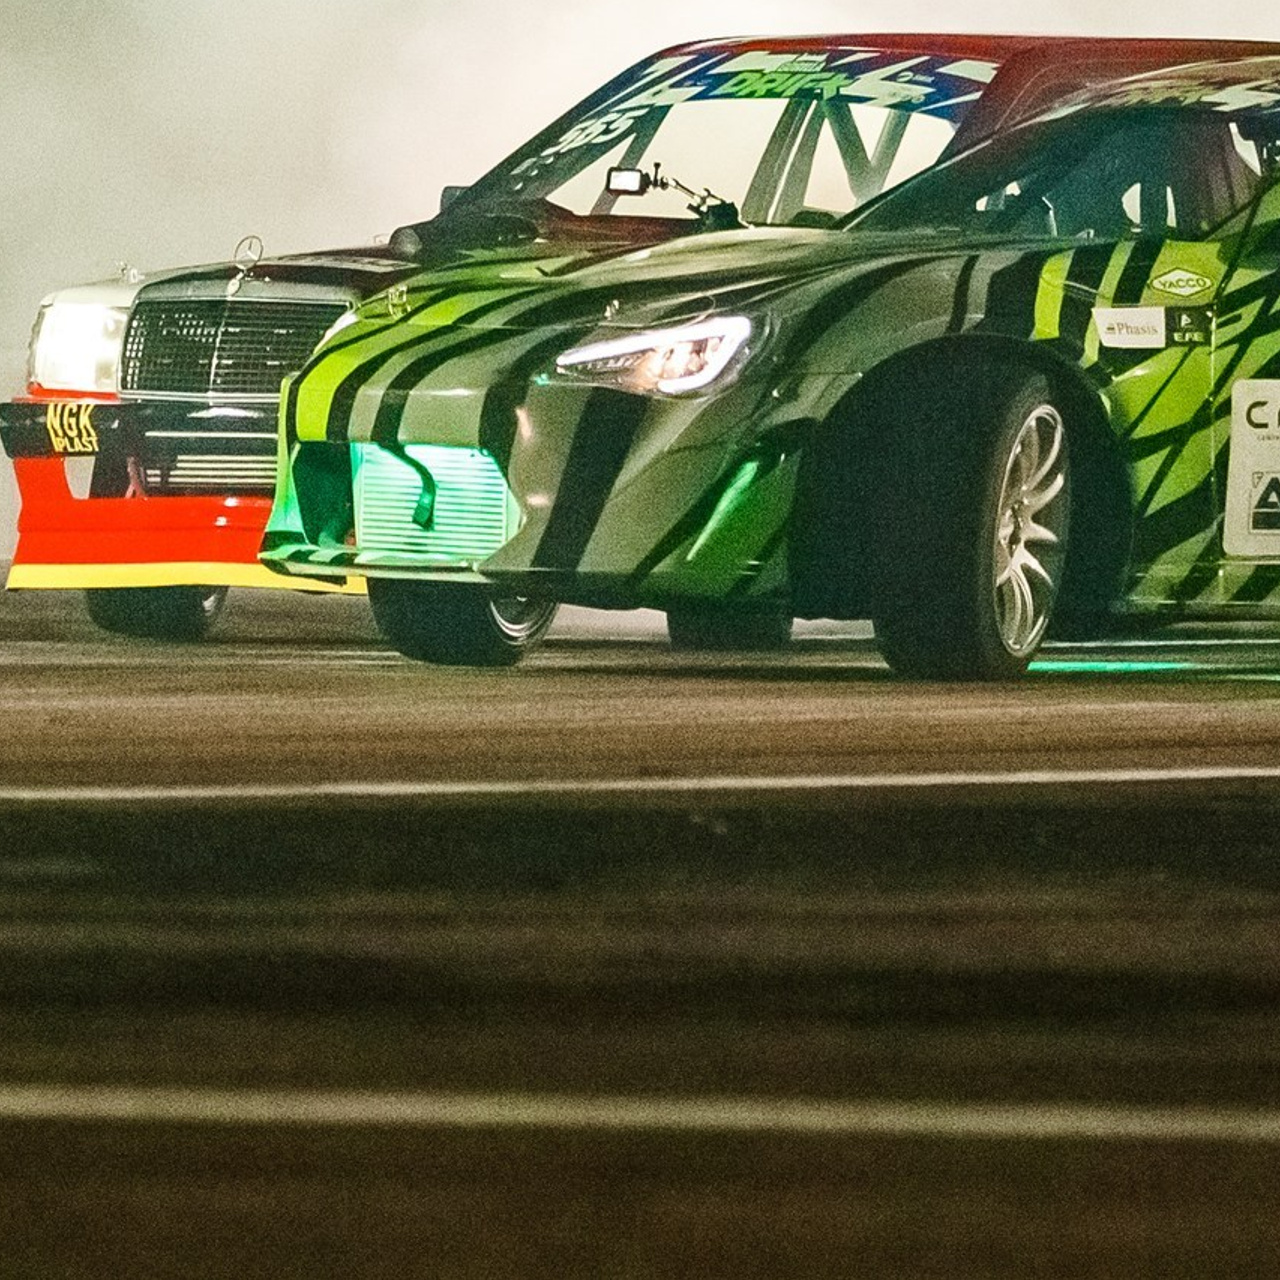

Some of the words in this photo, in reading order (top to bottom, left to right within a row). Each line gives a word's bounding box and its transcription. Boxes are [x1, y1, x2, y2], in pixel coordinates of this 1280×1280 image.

[1159, 278, 1207, 289] YACCO
[1117, 322, 1158, 335] Phasis
[47, 402, 96, 437] NGK
[55, 436, 99, 452] PLAST
